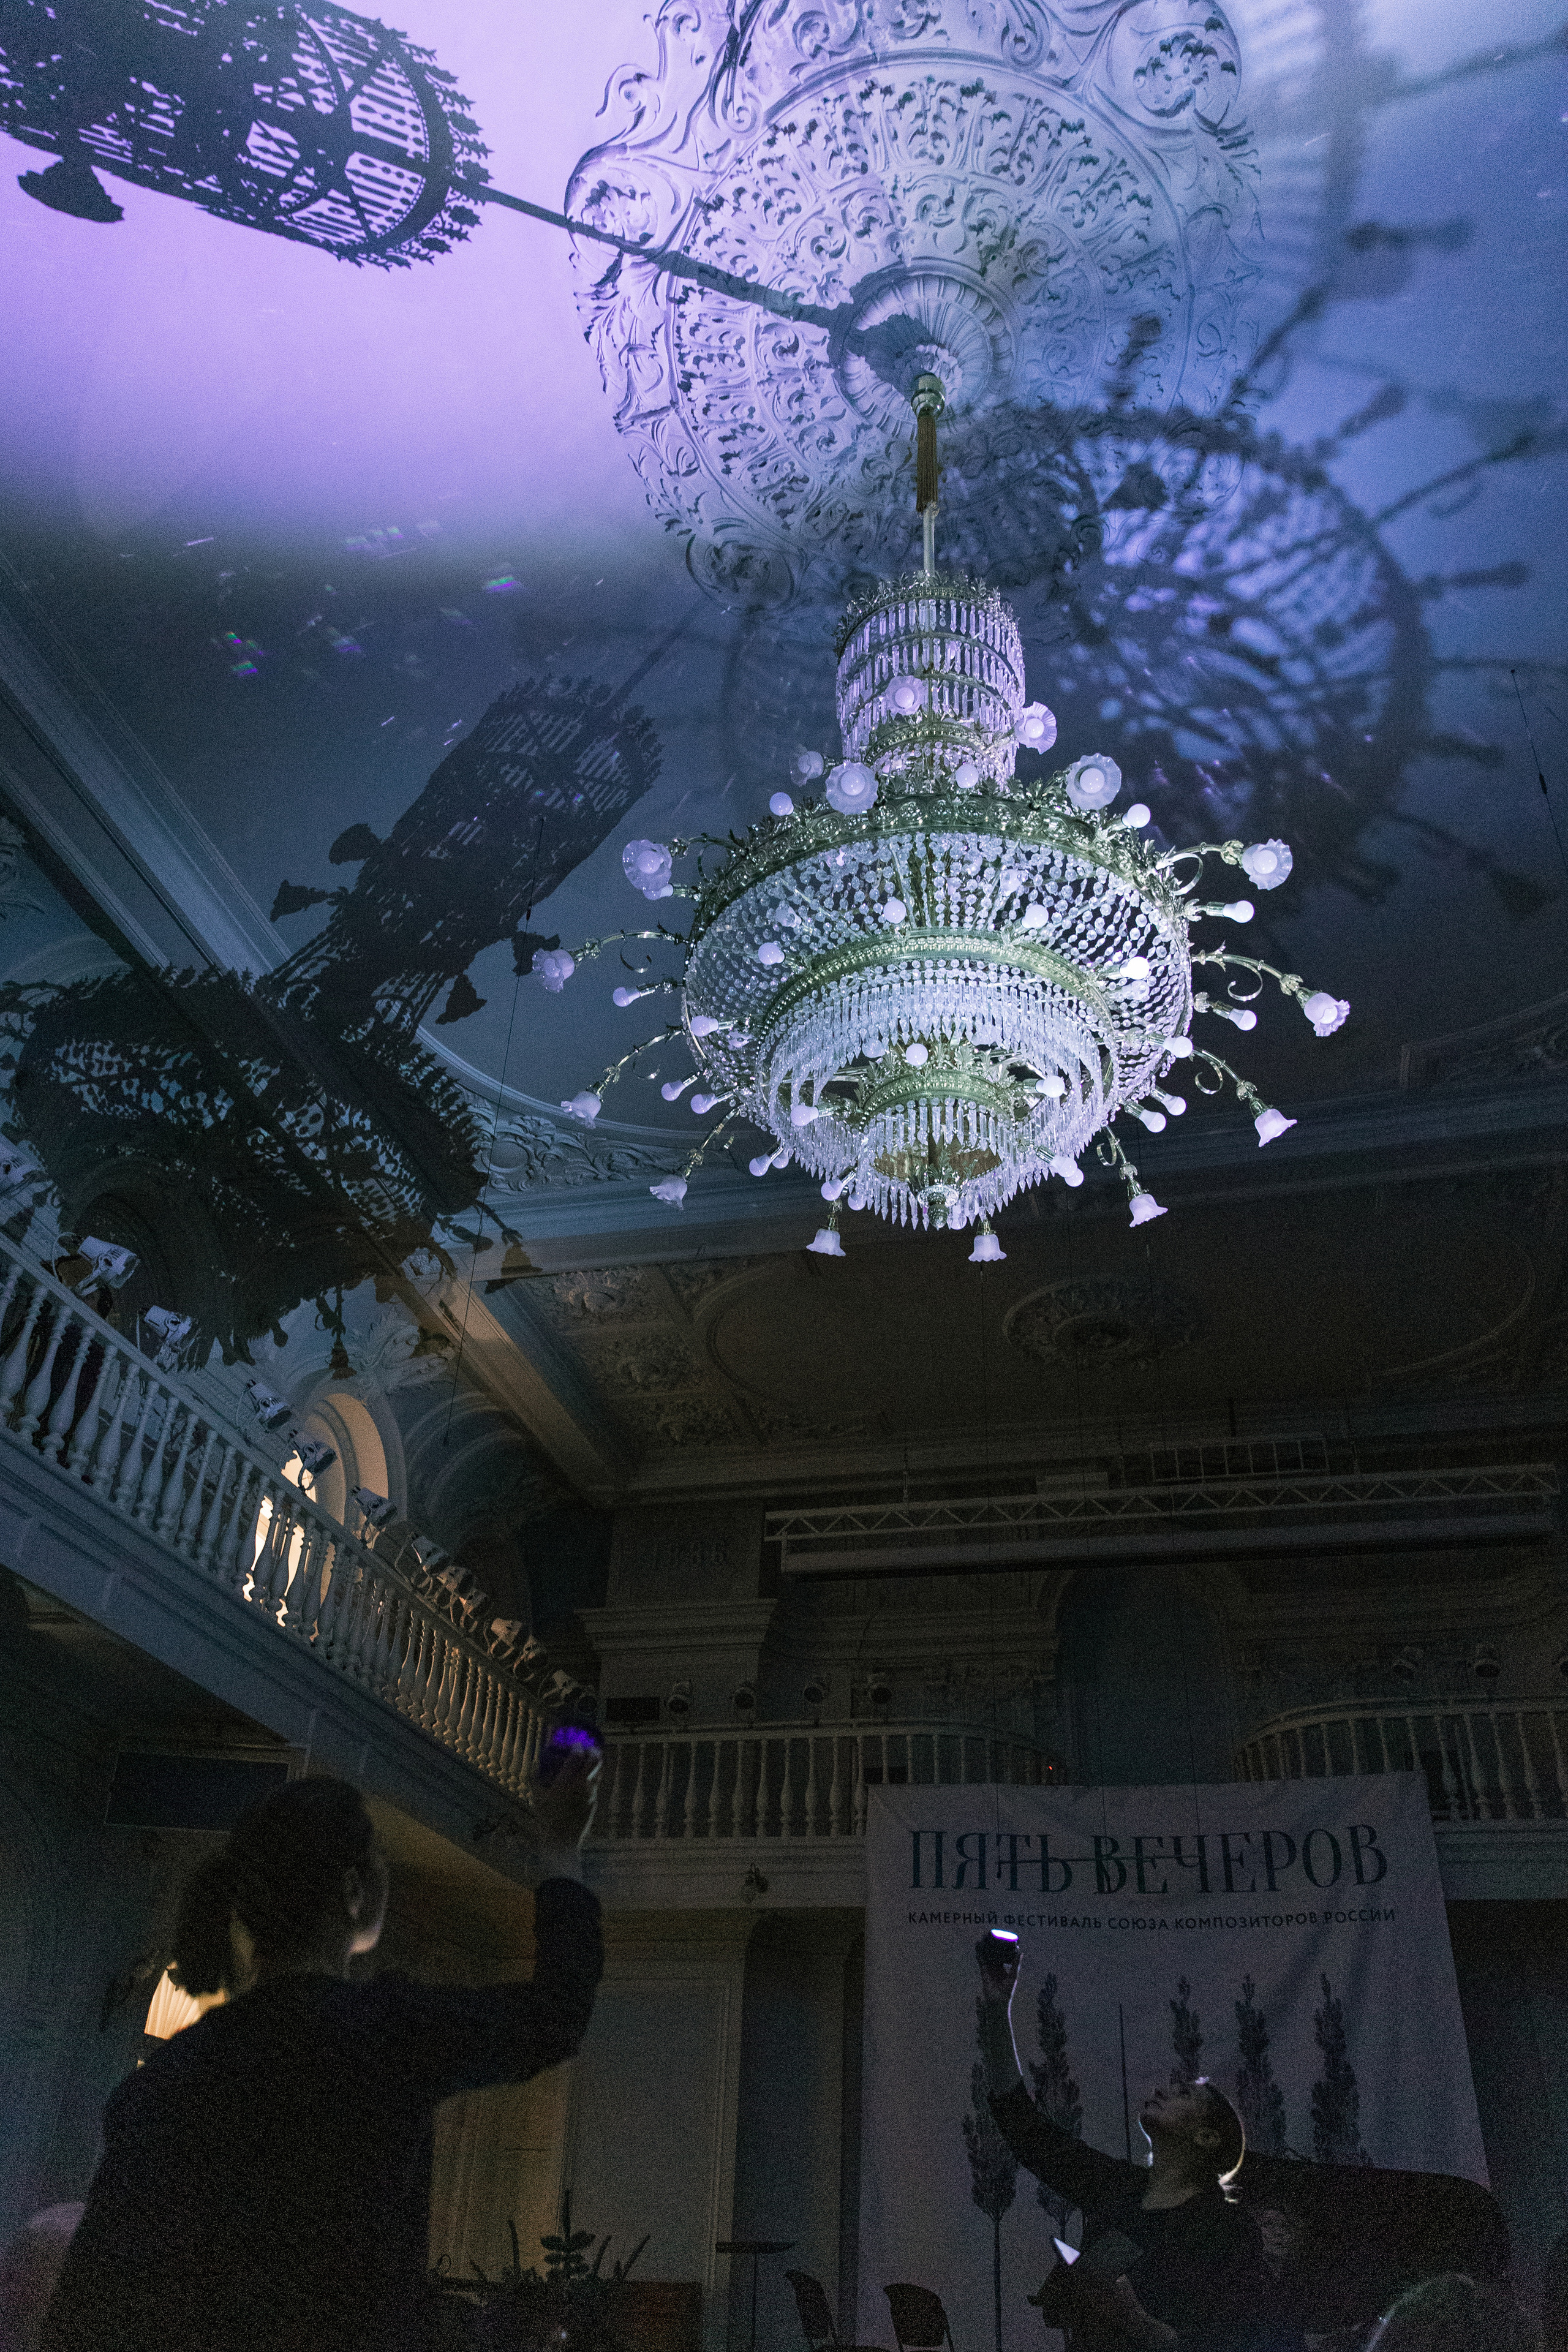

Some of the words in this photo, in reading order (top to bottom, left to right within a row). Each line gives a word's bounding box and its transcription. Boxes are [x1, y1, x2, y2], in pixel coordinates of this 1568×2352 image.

[909, 1830, 1072, 1893] ПЯТЬ
[1092, 1824, 1388, 1894] ВЕЧЕРОВ
[908, 1911, 998, 1925] КАМЕРНЫЙ
[1003, 1913, 1102, 1928] ФЕСТИВАЛЬ
[1107, 1917, 1169, 1930] СОЮЗА
[1175, 1912, 1317, 1929] КОМПОЗИТОРОВ
[1324, 1909, 1396, 1923] РОССИИ
